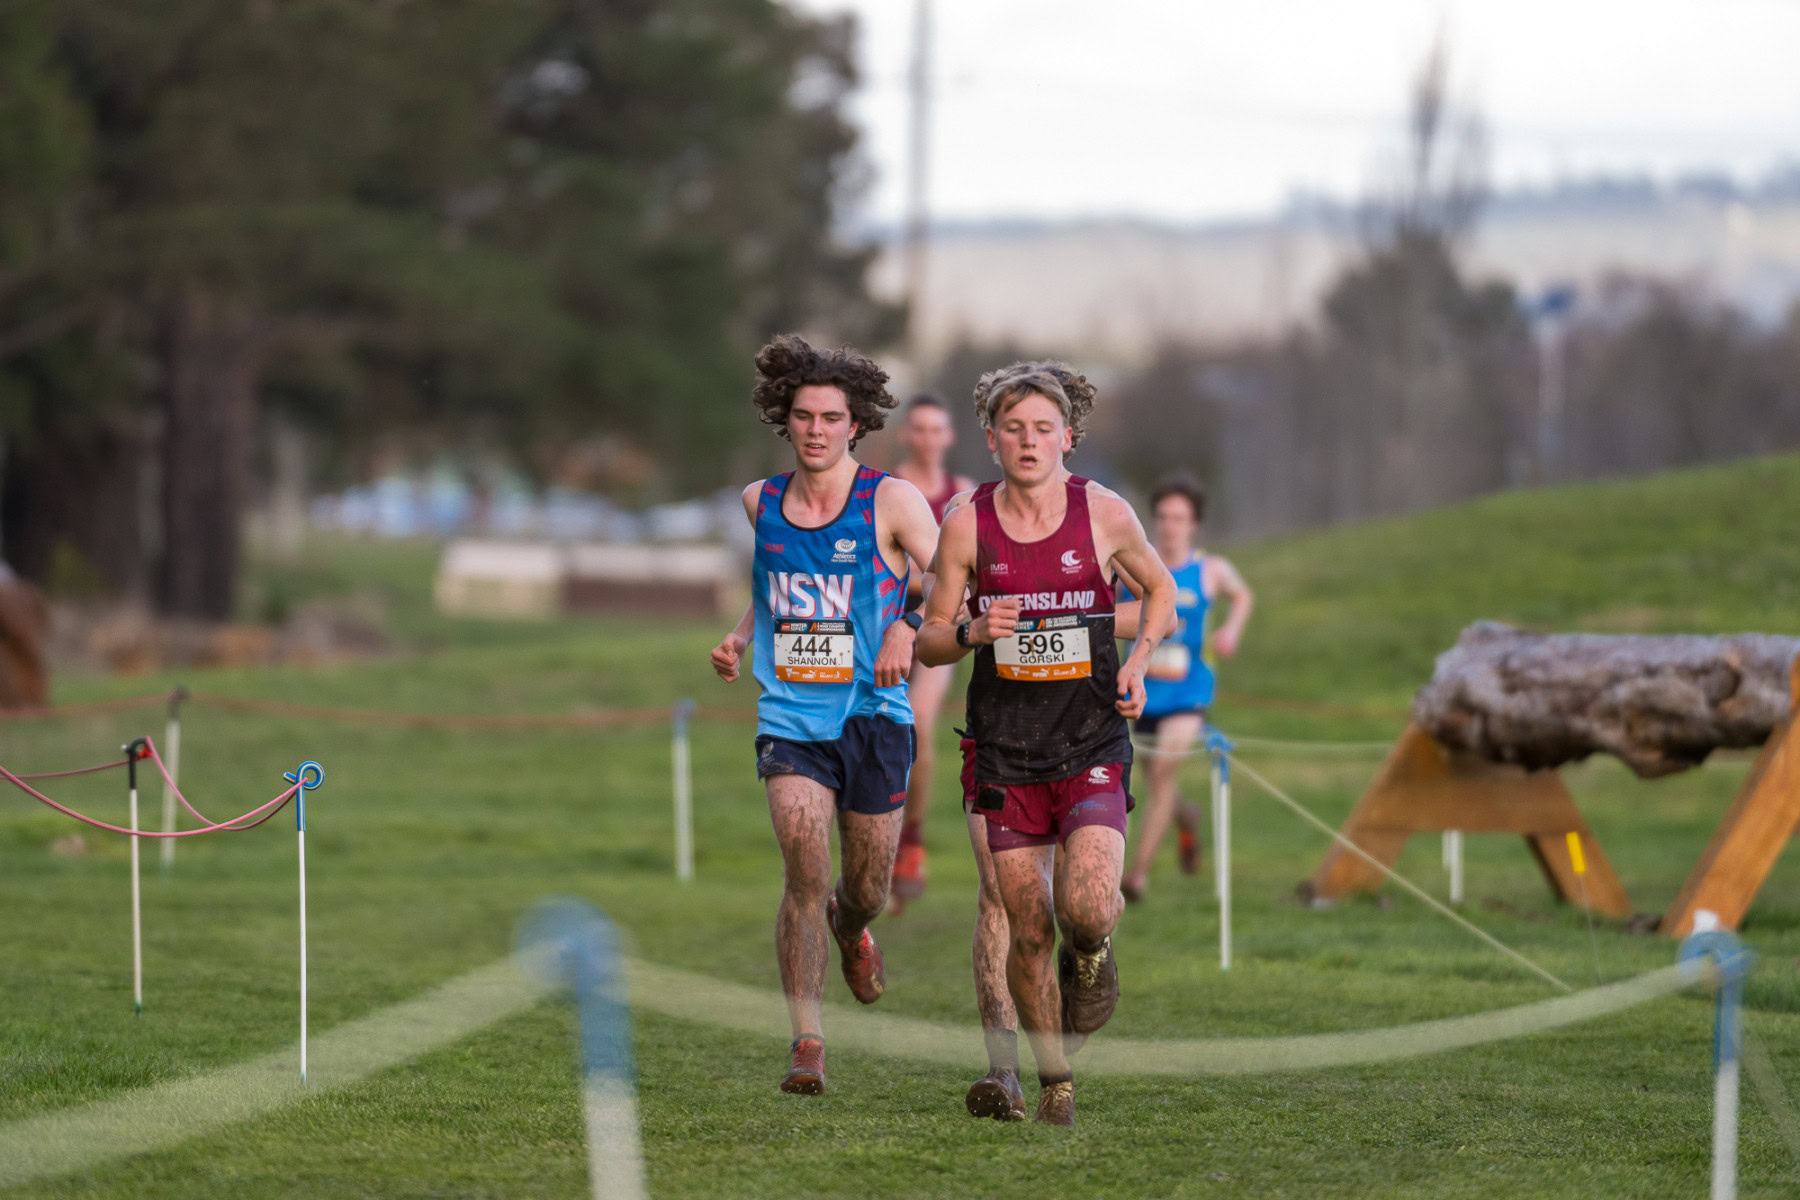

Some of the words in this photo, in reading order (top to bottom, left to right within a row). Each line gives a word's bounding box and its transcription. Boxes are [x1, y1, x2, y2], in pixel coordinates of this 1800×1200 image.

[767, 571, 854, 619] NSW
[791, 635, 832, 657] 444
[1018, 632, 1064, 655] 596
[787, 656, 837, 666] SHANNON
[1019, 654, 1065, 664] GORSKI
